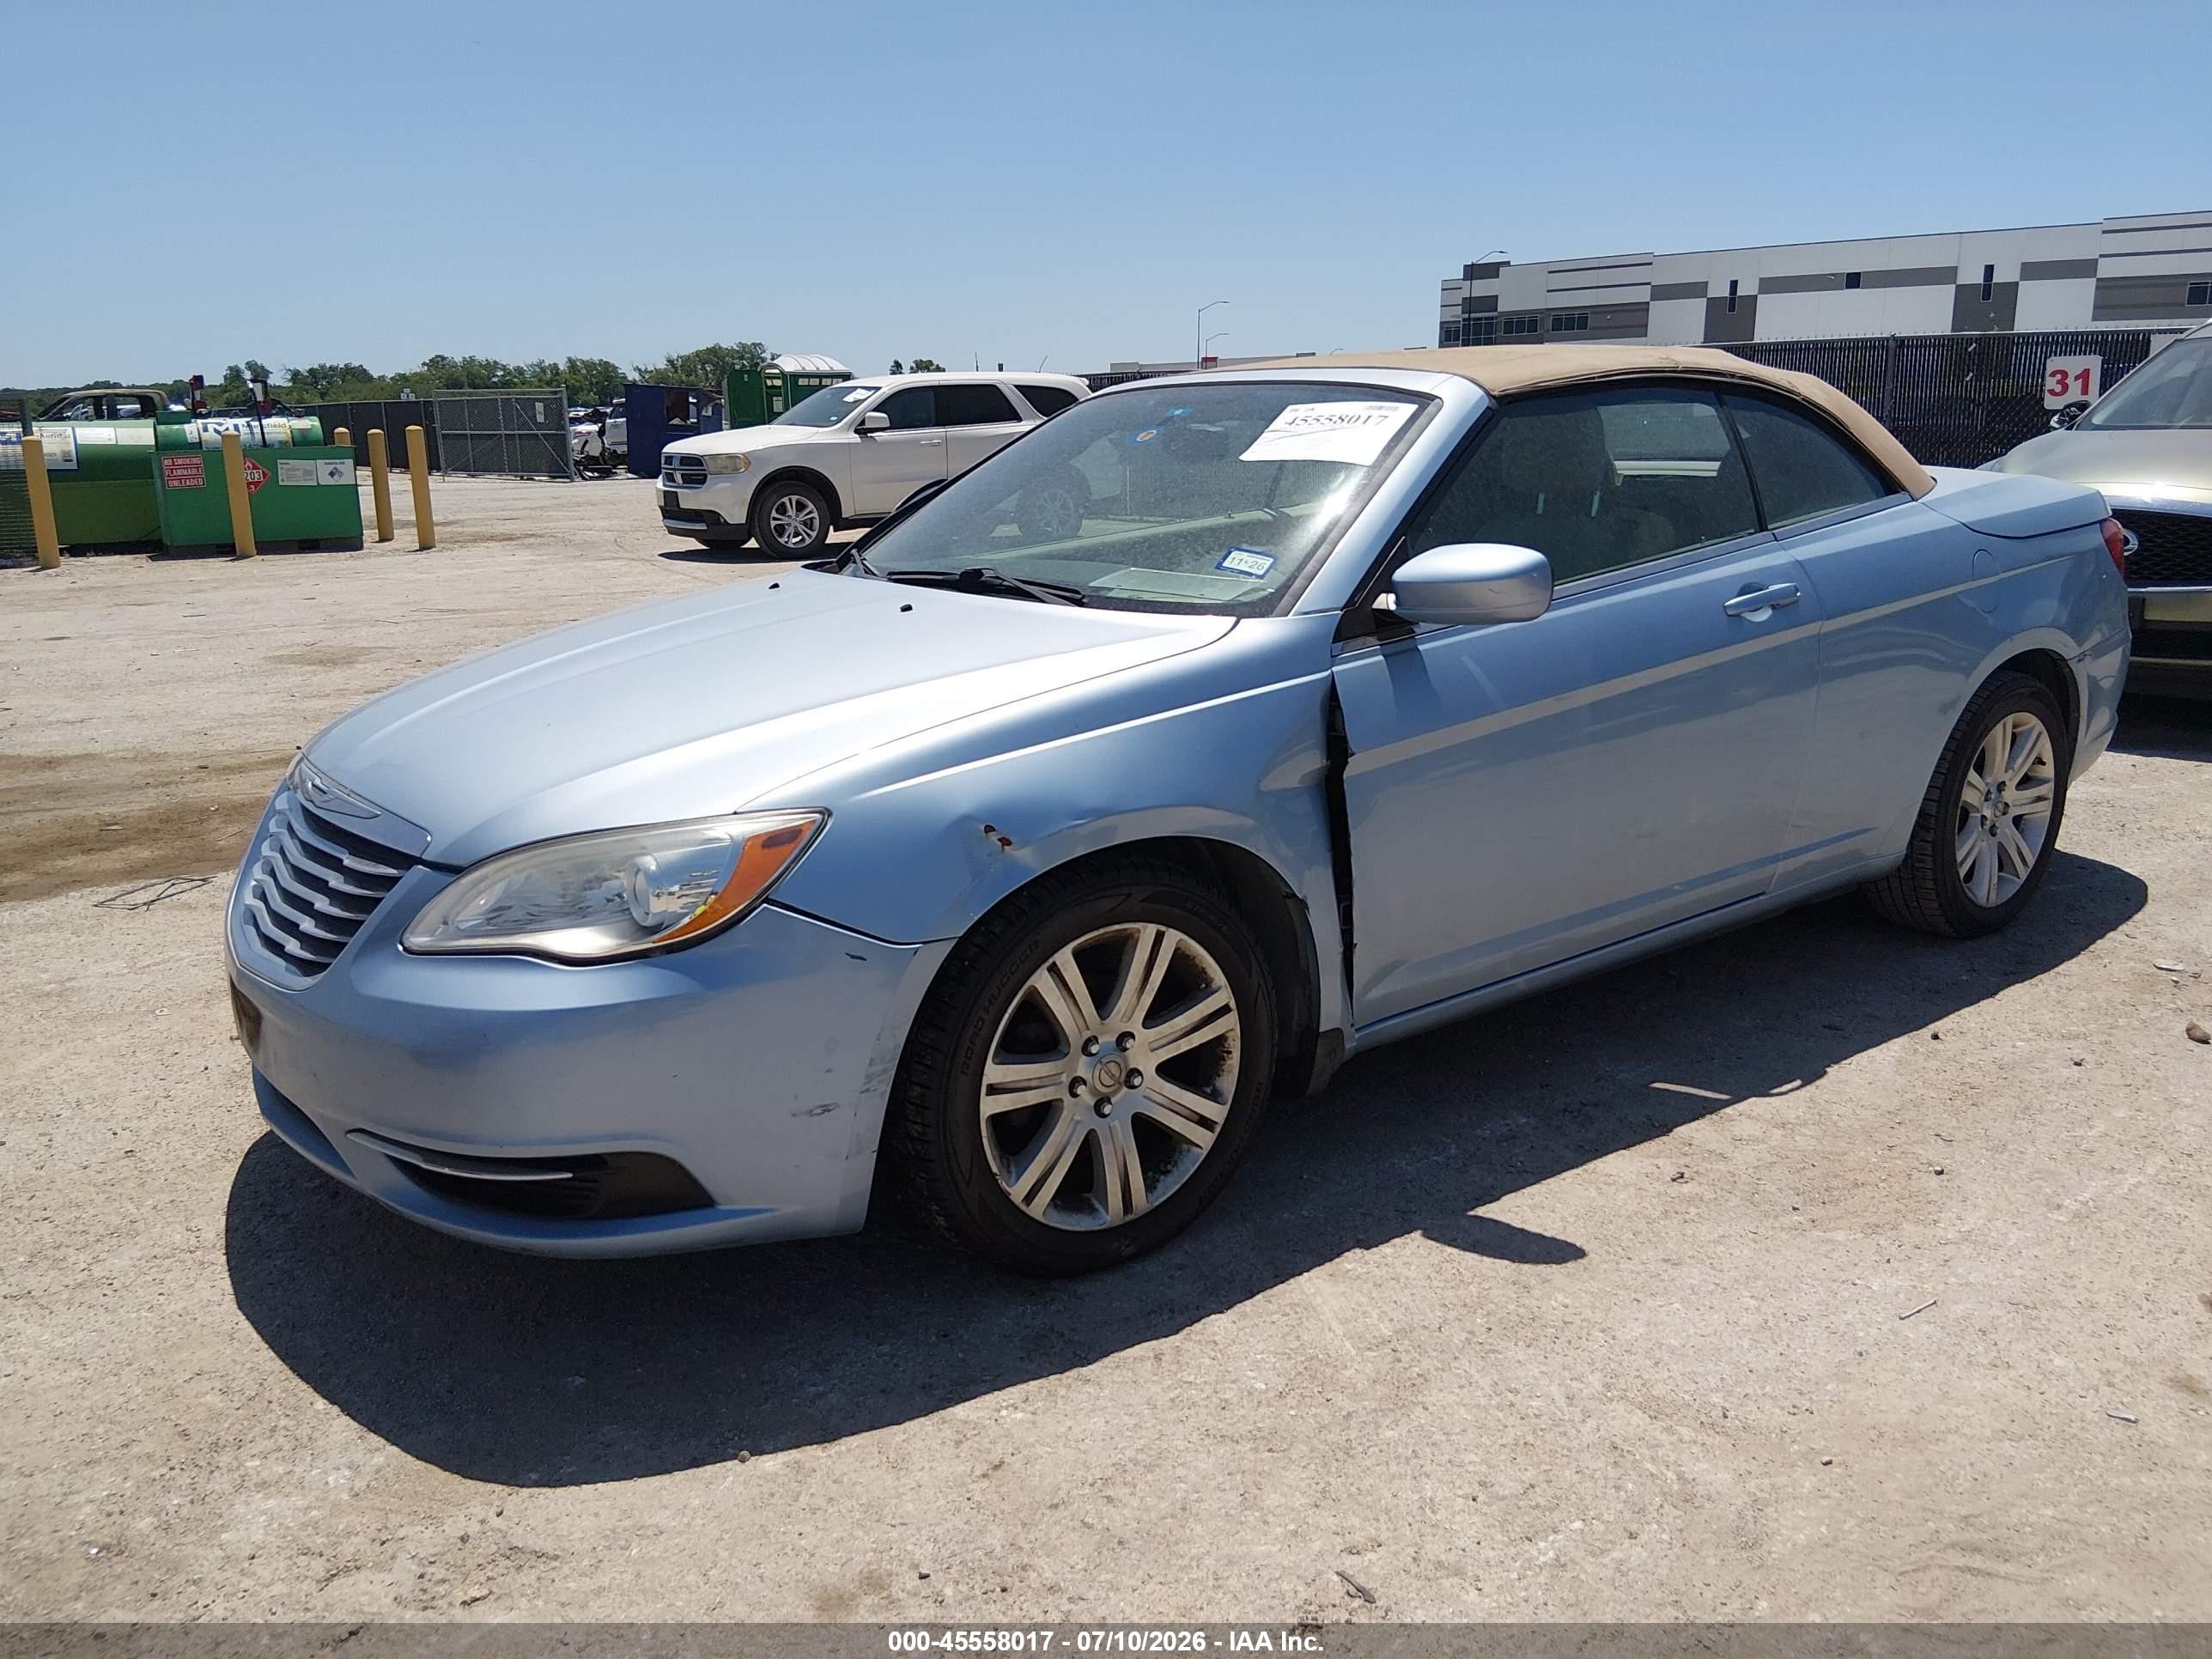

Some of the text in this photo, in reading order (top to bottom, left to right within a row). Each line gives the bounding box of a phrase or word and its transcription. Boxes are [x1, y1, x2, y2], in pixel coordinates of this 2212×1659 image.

[2046, 368, 2091, 397] 31
[1285, 414, 1389, 426] 45558017
[165, 467, 204, 477] FLAMMABLE
[245, 471, 262, 481] 203
[168, 477, 204, 487] UNLEADED
